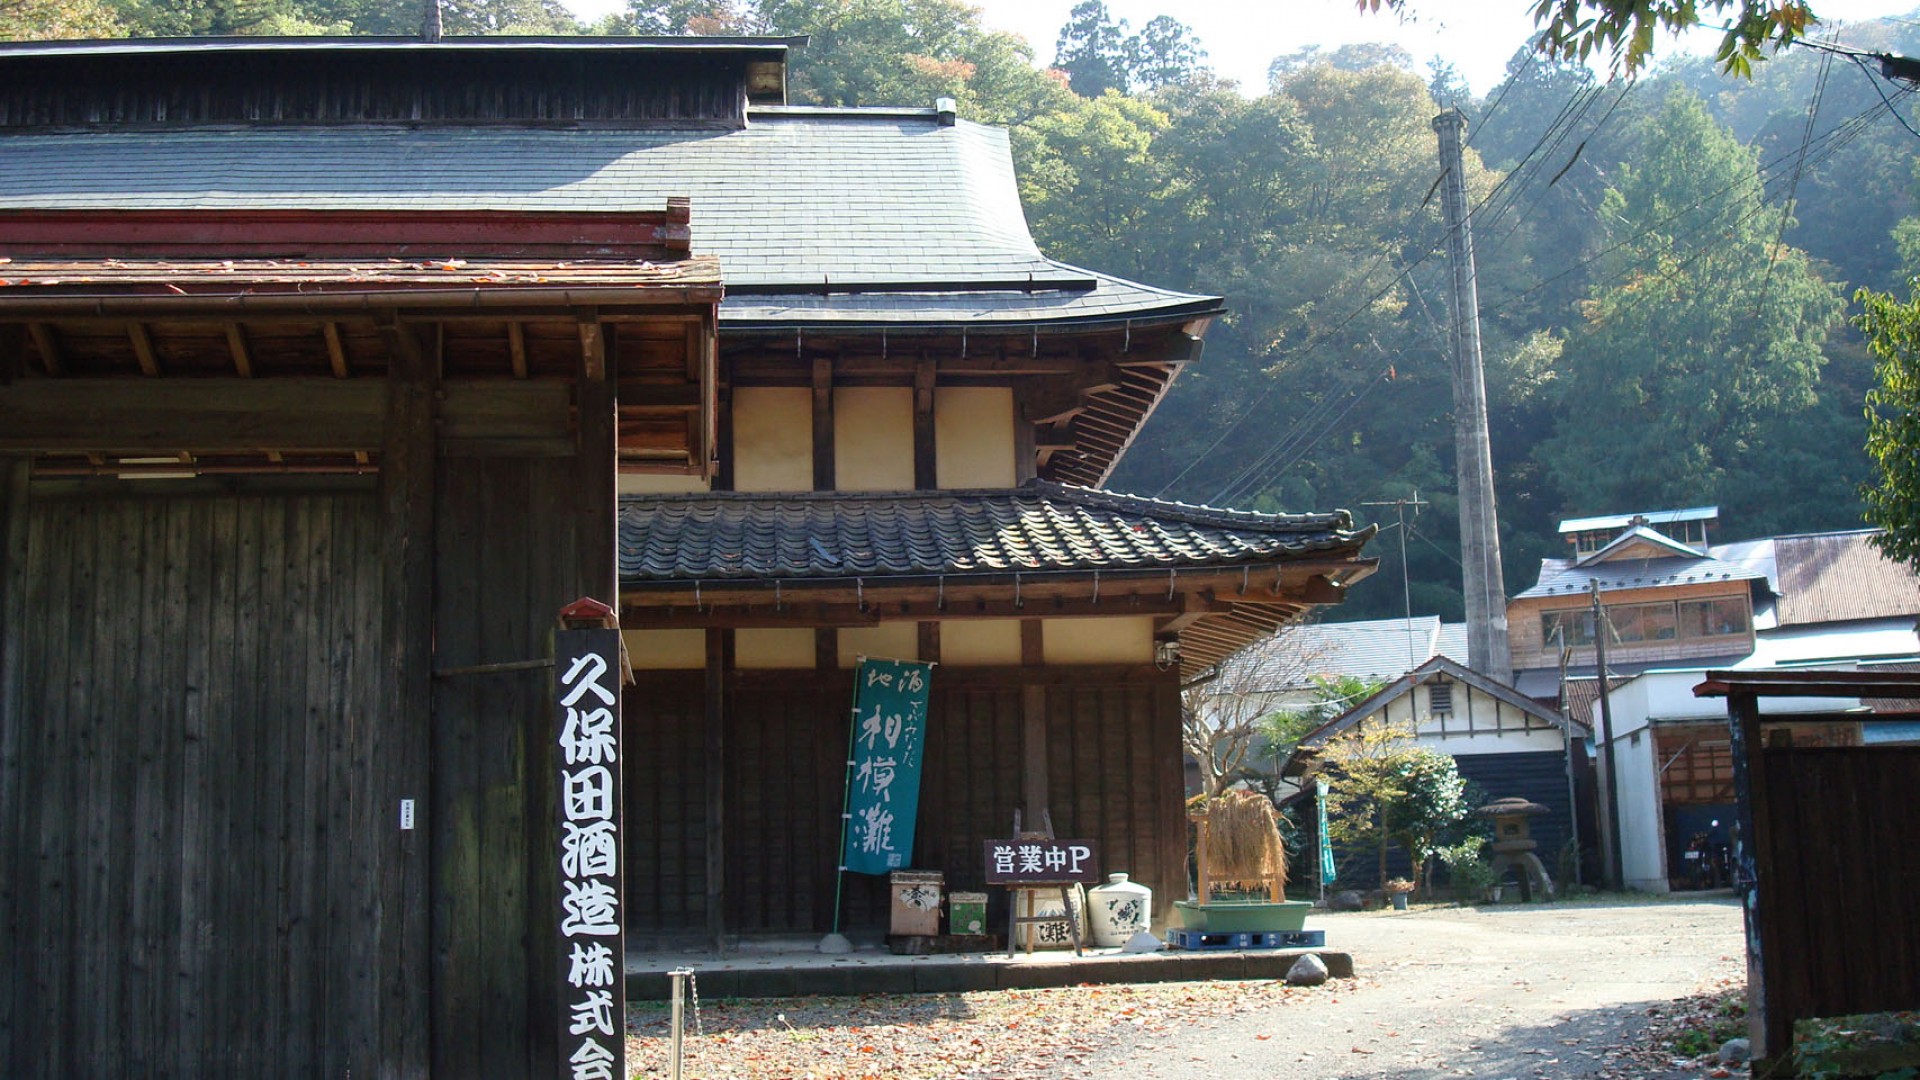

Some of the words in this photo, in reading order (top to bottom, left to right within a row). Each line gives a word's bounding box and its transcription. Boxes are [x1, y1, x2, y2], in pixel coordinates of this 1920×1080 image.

[867, 668, 923, 693] 地酒
[852, 704, 902, 855] 相模灘
[558, 652, 620, 1080] 久保田酒造株式会
